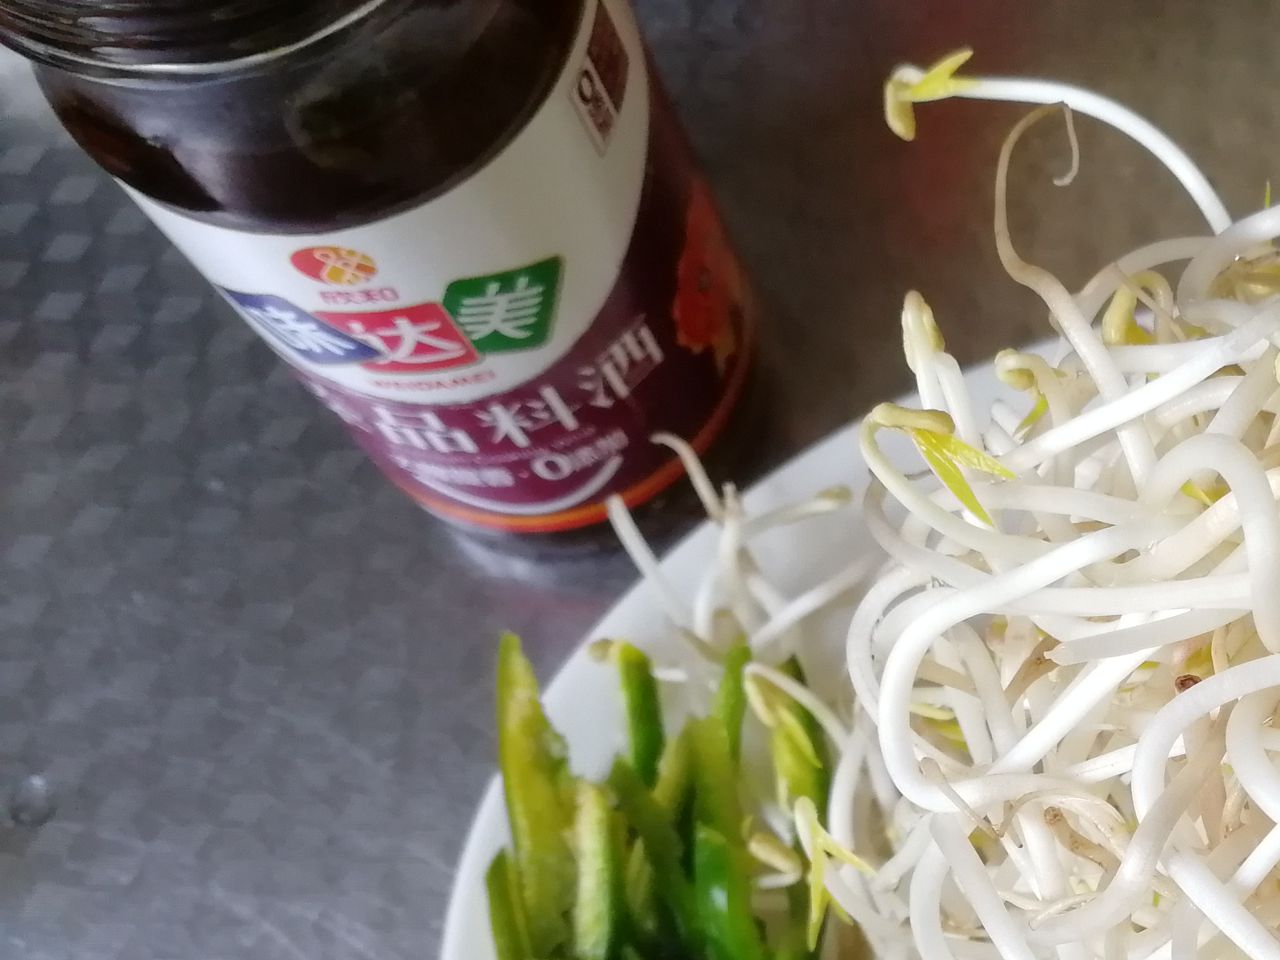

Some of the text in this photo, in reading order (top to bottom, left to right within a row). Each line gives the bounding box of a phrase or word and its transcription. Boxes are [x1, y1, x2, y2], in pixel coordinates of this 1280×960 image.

[242, 277, 545, 363] 味达美
[312, 313, 664, 453] 品料酒
